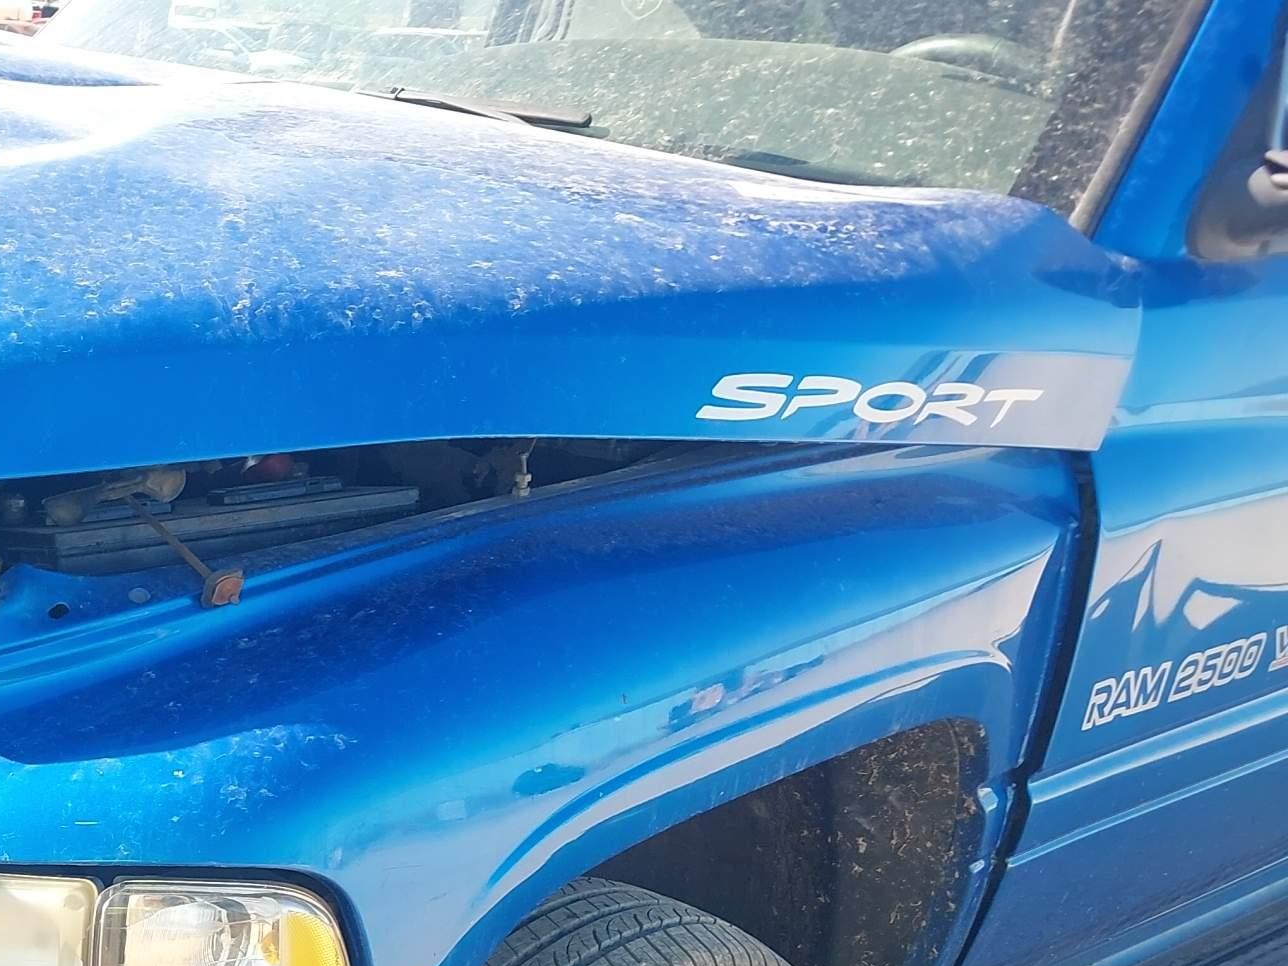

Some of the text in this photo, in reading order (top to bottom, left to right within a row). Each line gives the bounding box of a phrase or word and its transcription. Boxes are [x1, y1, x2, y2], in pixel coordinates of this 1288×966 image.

[695, 373, 1045, 428] SPORT
[1081, 661, 1173, 731] RAM
[1167, 632, 1267, 703] 2500
